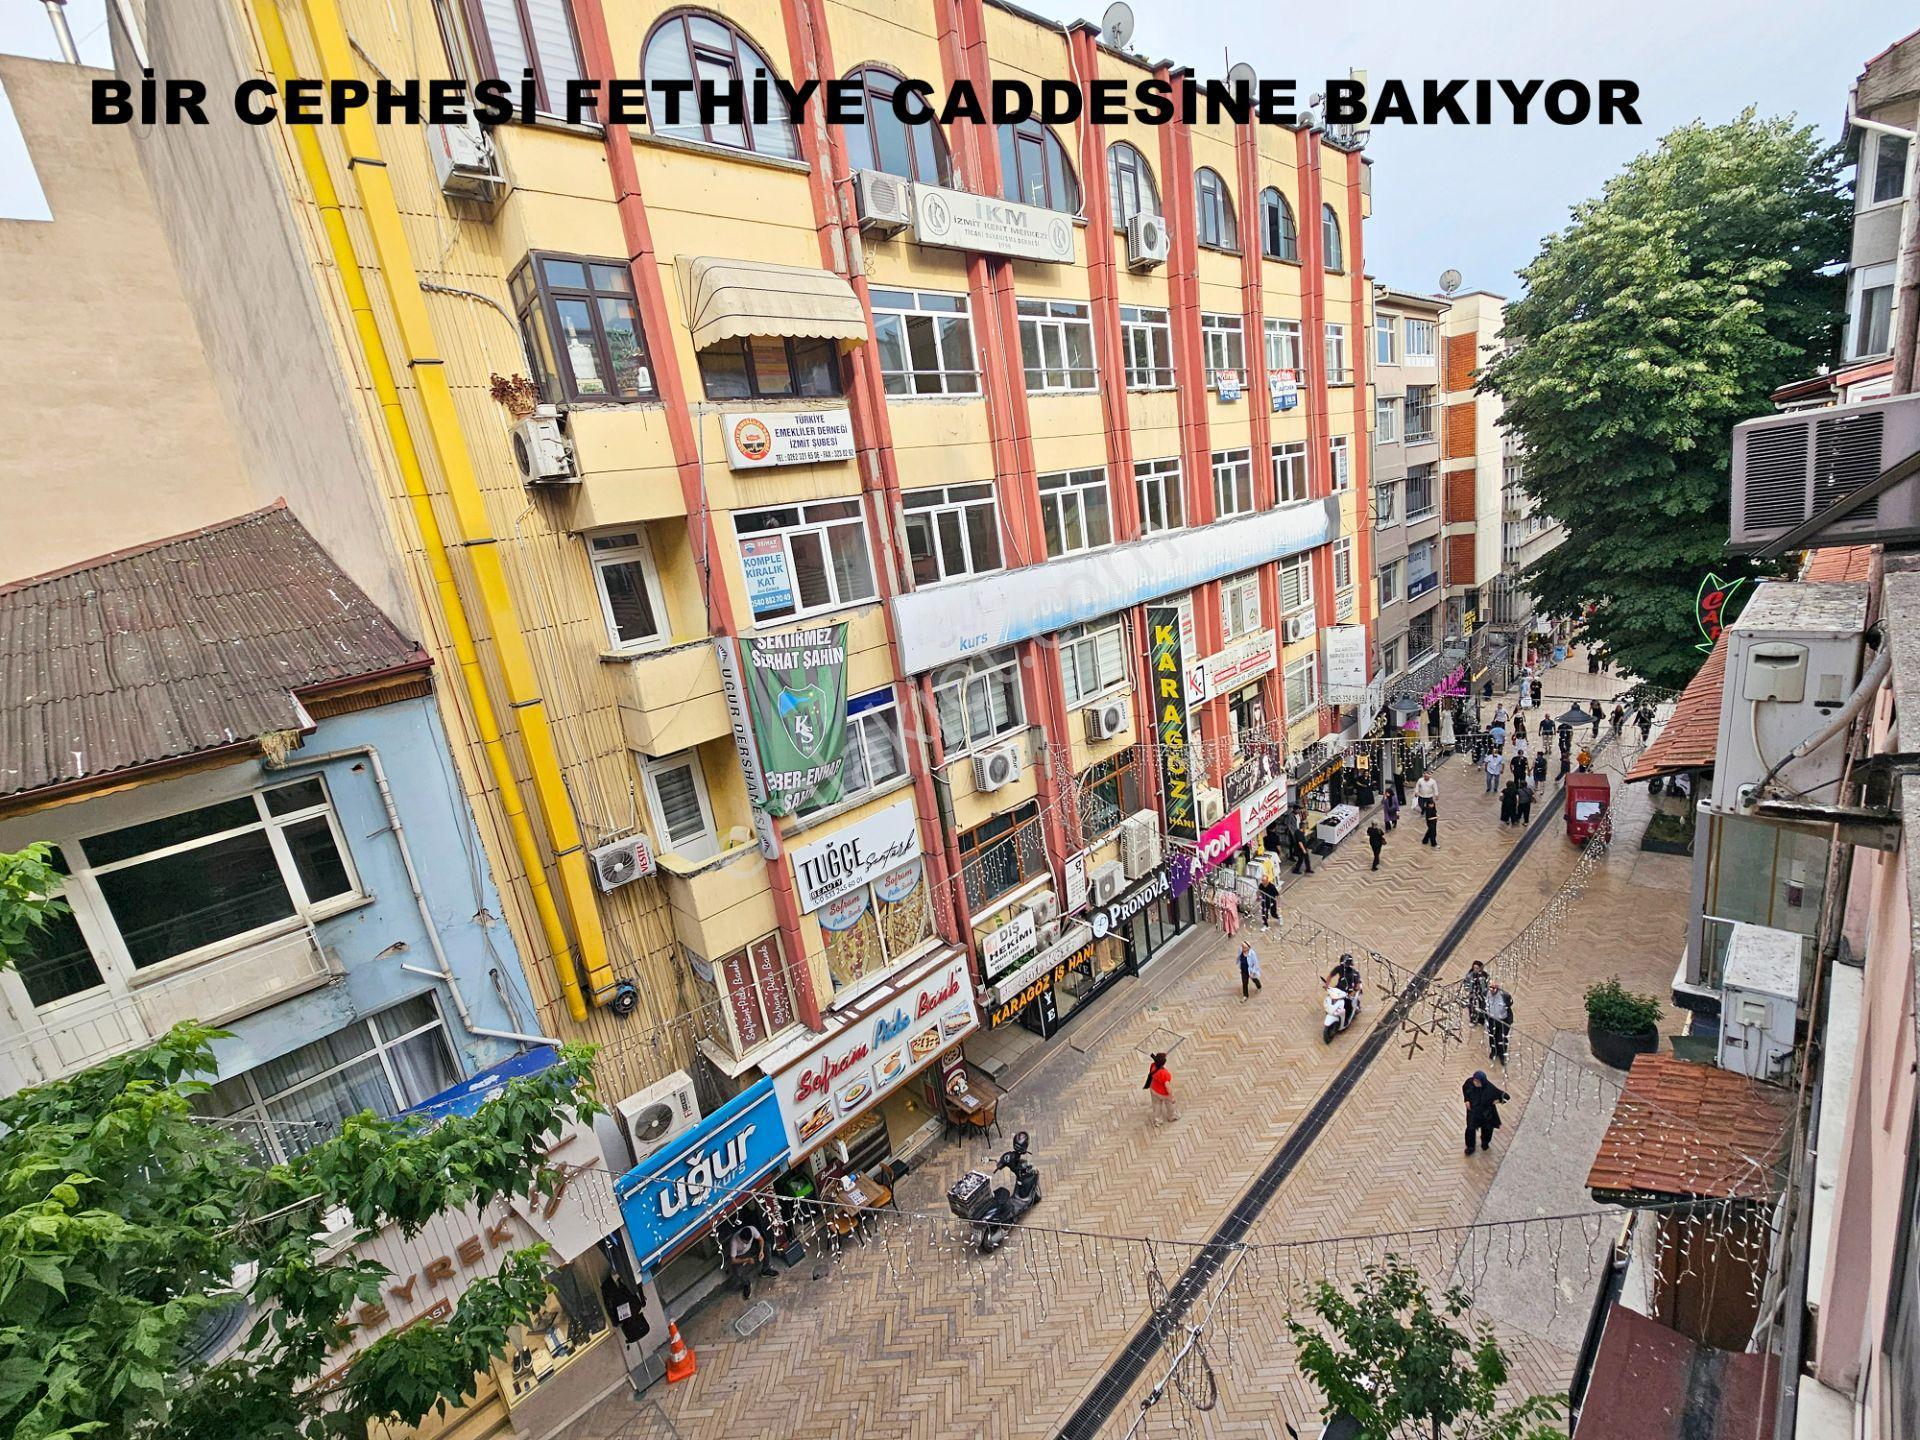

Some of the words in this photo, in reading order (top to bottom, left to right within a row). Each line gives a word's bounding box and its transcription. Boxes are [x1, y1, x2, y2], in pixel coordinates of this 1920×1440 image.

[975, 199, 1028, 228] İKM
[953, 214, 980, 229] İZMİT
[984, 222, 1007, 233] KENT
[1010, 227, 1048, 241] MERKEZİ
[775, 426, 816, 438] EMEKLİLER
[817, 423, 848, 435] DERNEĞİ
[795, 413, 826, 425] TÜRKİYE
[789, 437, 811, 449] İZMİT
[812, 436, 838, 449] ŞUBESİ
[743, 554, 782, 568] KOMPLE
[745, 565, 784, 579] KİRALIK
[757, 576, 776, 588] KAT
[959, 630, 989, 654] kurs
[751, 649, 800, 671] SERHAT
[802, 644, 844, 670] ŞAHİN
[1155, 625, 1188, 801] KARAGÖZ
[1168, 816, 1196, 829] HANI
[635, 842, 649, 873] VESTEL
[798, 837, 866, 892] TUĞÇE
[1190, 830, 1230, 874] AVON
[810, 878, 843, 901] BEAUTY
[884, 866, 914, 889] Sofram
[825, 891, 836, 902] 533
[829, 894, 861, 917] Sofram
[1107, 871, 1171, 929] PRONOVA
[989, 926, 1034, 962] HEKİMİ
[999, 921, 1021, 944] DİŞ
[758, 944, 772, 970] Bank
[728, 959, 743, 986] Bank
[991, 974, 1052, 1029] KARAGÖZ
[1054, 963, 1066, 984] İŞ
[1067, 943, 1098, 973] HANI
[793, 1041, 870, 1103] Sofram
[871, 1006, 911, 1051] Pide
[914, 971, 960, 1022] Bank
[659, 1122, 757, 1219] uğur
[713, 1162, 747, 1195] kurs
